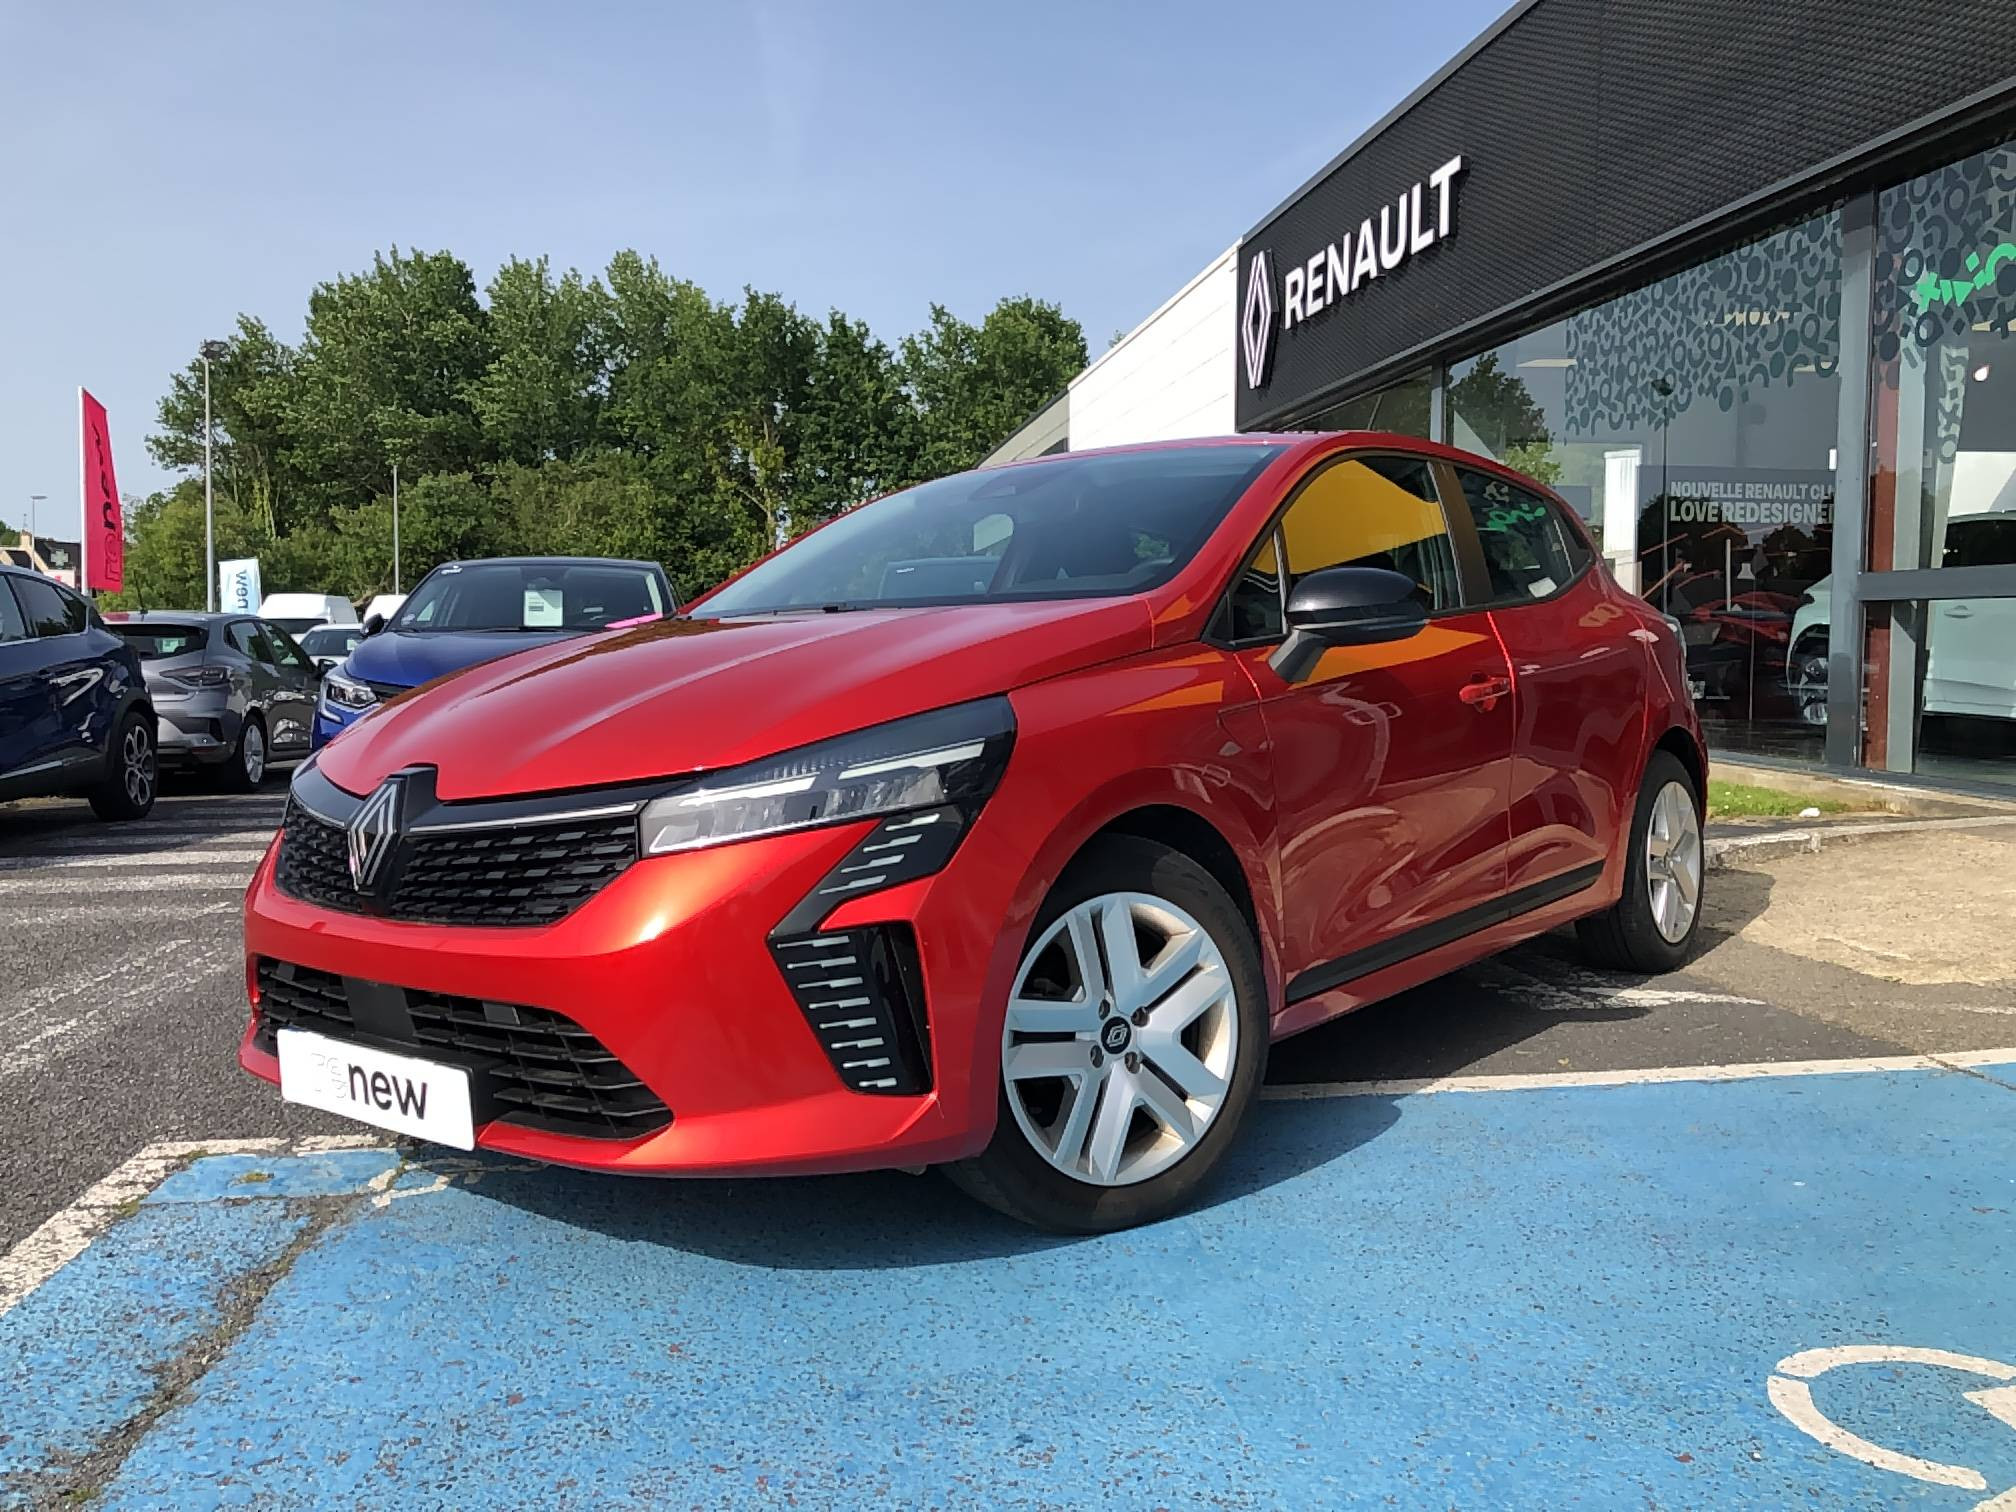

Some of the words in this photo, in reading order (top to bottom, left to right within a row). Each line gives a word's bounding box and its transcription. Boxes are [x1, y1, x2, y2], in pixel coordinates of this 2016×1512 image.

[1285, 154, 1462, 330] RENAULT
[1670, 481, 1744, 498] NOUVELLE
[1745, 483, 1808, 500] RENAULT
[1670, 500, 1719, 523] LOVE
